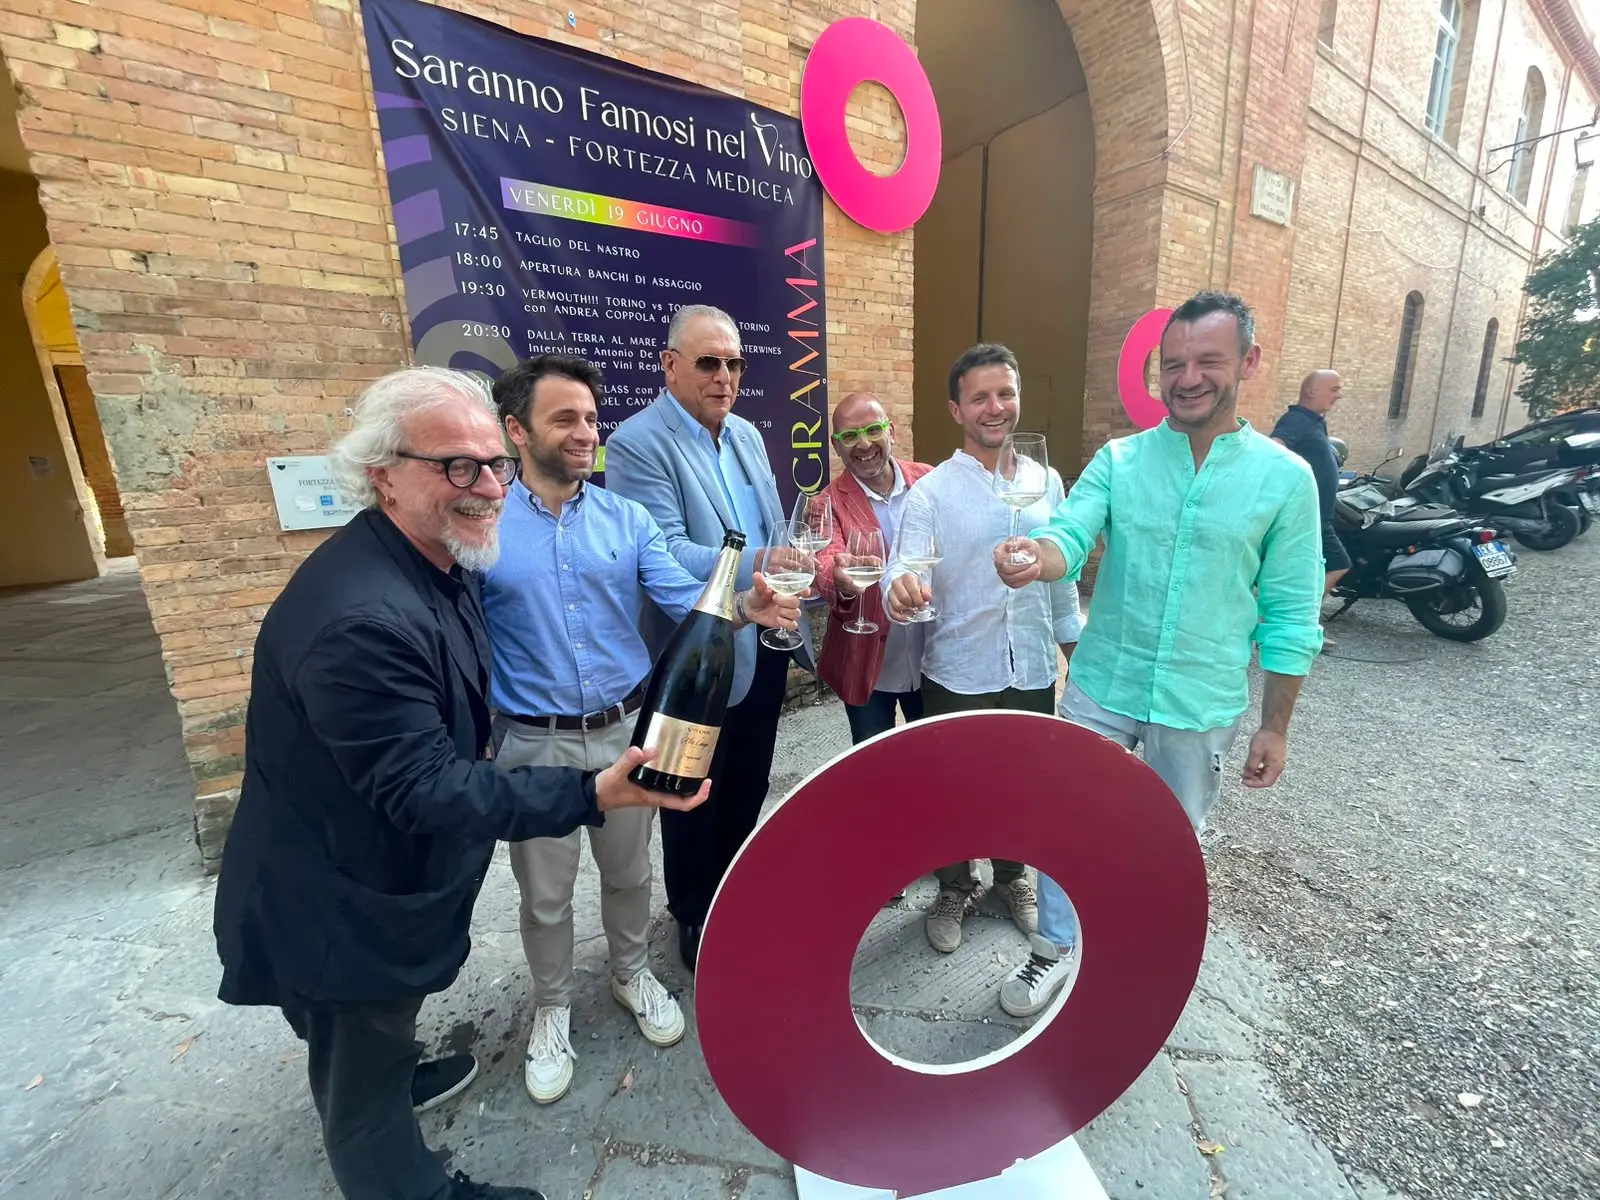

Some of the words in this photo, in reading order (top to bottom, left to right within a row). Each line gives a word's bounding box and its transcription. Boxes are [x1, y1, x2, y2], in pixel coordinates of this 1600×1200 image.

[391, 39, 563, 113] Saranno
[580, 87, 695, 147] Famosi
[706, 128, 746, 160] nel
[750, 112, 812, 179] Vino
[441, 108, 531, 148] SIENA
[569, 136, 696, 183] FORTEZZA
[706, 167, 795, 206] MEDICEA
[509, 187, 596, 216] VENERDÌ
[607, 205, 624, 221] 19
[636, 210, 703, 234] GIUGNO
[454, 222, 499, 240] 17:45
[515, 231, 561, 248] TAGLIO
[568, 239, 591, 252] DEL
[597, 243, 641, 259] NASTRO
[456, 252, 502, 268] 18:00
[519, 260, 581, 277] APERTURA
[588, 269, 629, 283] BANCHI
[635, 274, 646, 285] DI
[651, 276, 702, 291] ASSAGGIO
[461, 281, 505, 297] 19:30
[522, 288, 599, 305] VERMOUTH!!!
[605, 296, 646, 309] TORINO
[651, 303, 663, 311] vs
[524, 304, 546, 313] con
[554, 304, 599, 318] ANDREA
[605, 310, 656, 323] COPPOLA
[661, 315, 670, 323] di
[738, 321, 770, 333] TORINO
[462, 323, 511, 338] 20:30
[527, 329, 564, 341] DALLA
[571, 332, 606, 344] TERRA
[611, 335, 625, 345] AL
[630, 337, 657, 347] MARE
[740, 344, 782, 355] ATERWINES
[528, 343, 587, 355] Interviene
[594, 347, 634, 358] Antonio
[640, 349, 654, 359] De
[612, 360, 633, 370] Vini
[784, 238, 824, 494] GRAMMA
[635, 387, 653, 395] con
